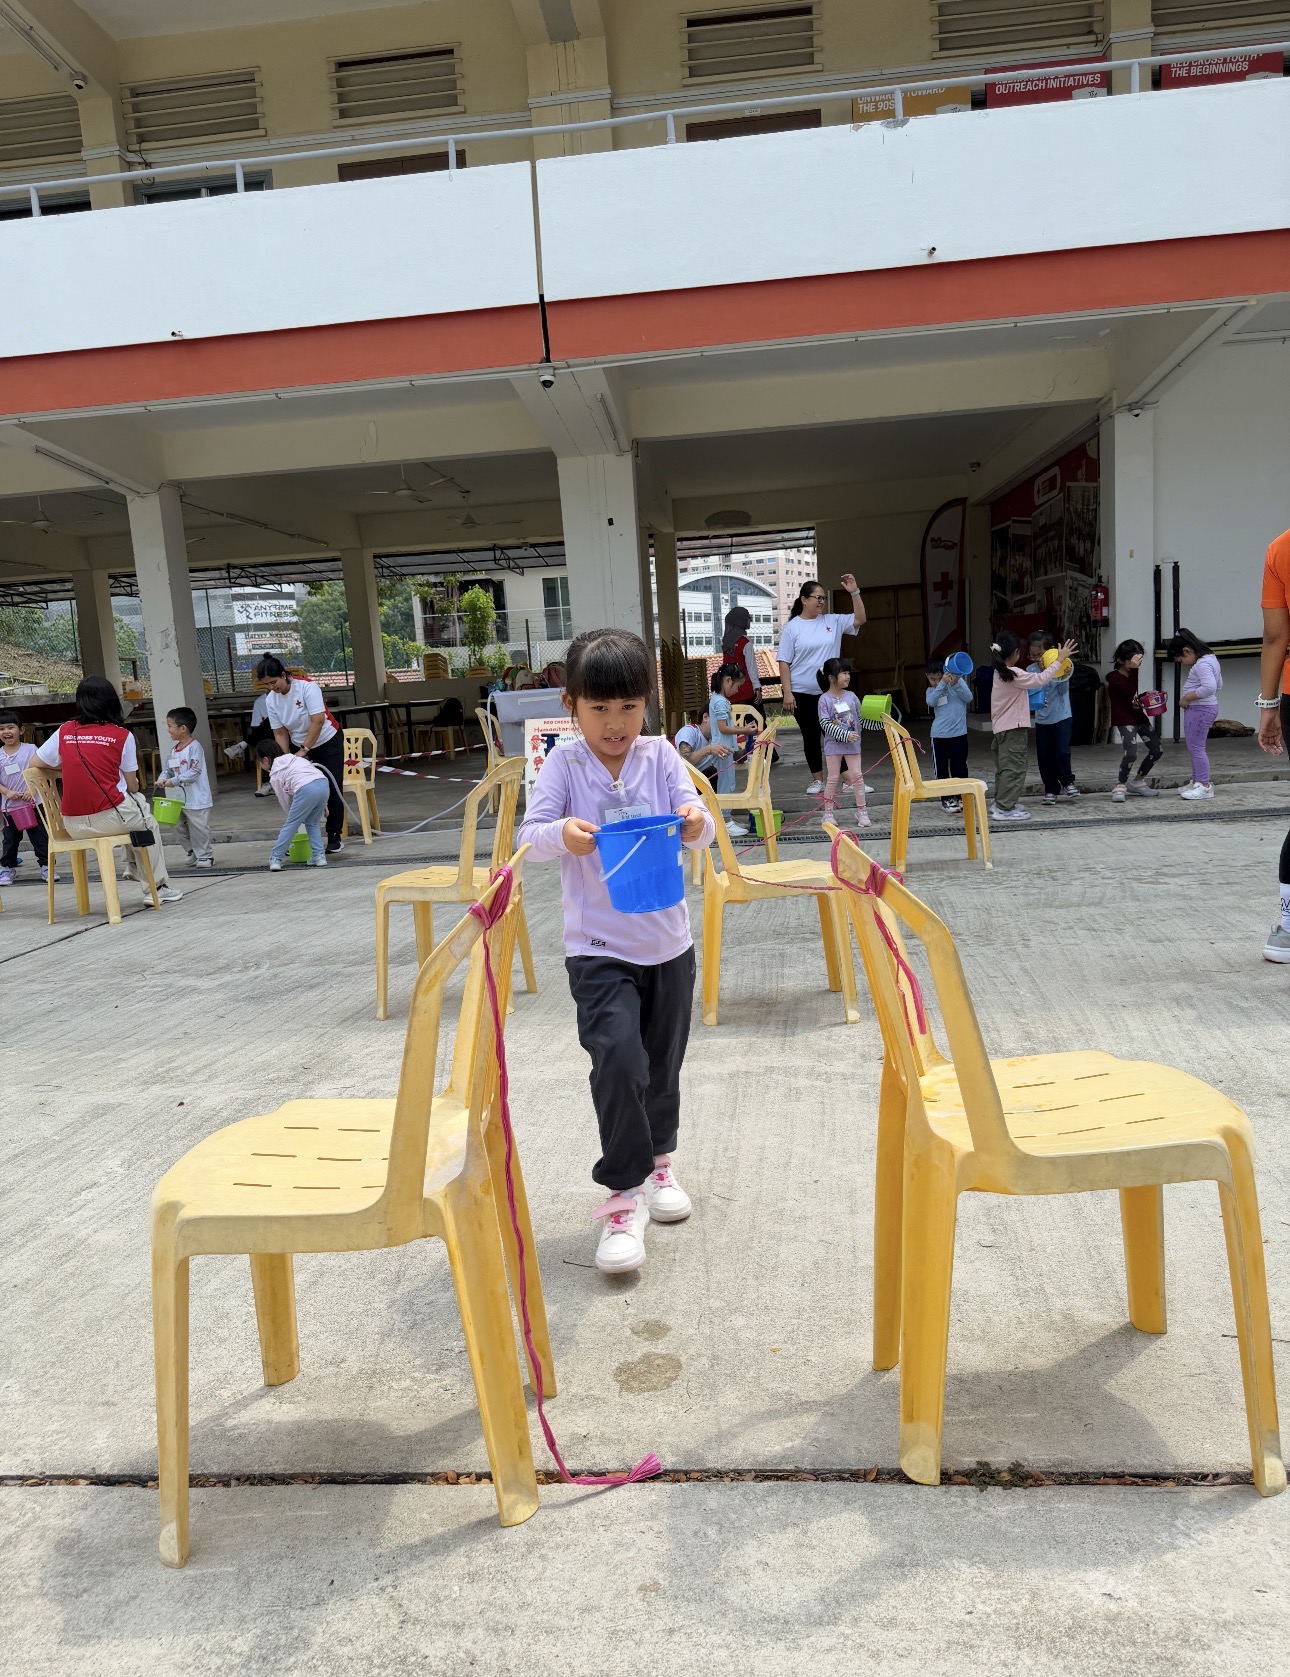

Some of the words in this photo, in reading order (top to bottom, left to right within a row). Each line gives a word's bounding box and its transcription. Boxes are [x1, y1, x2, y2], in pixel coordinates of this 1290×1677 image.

[1171, 67, 1189, 78] THE
[1190, 61, 1249, 76] BEGINNINGS
[995, 80, 1046, 95] OUTREACH
[1047, 73, 1101, 89] INITIATIVES
[858, 102, 876, 114] THE
[877, 100, 896, 111] 90S
[94, 735, 117, 744] YOUTH
